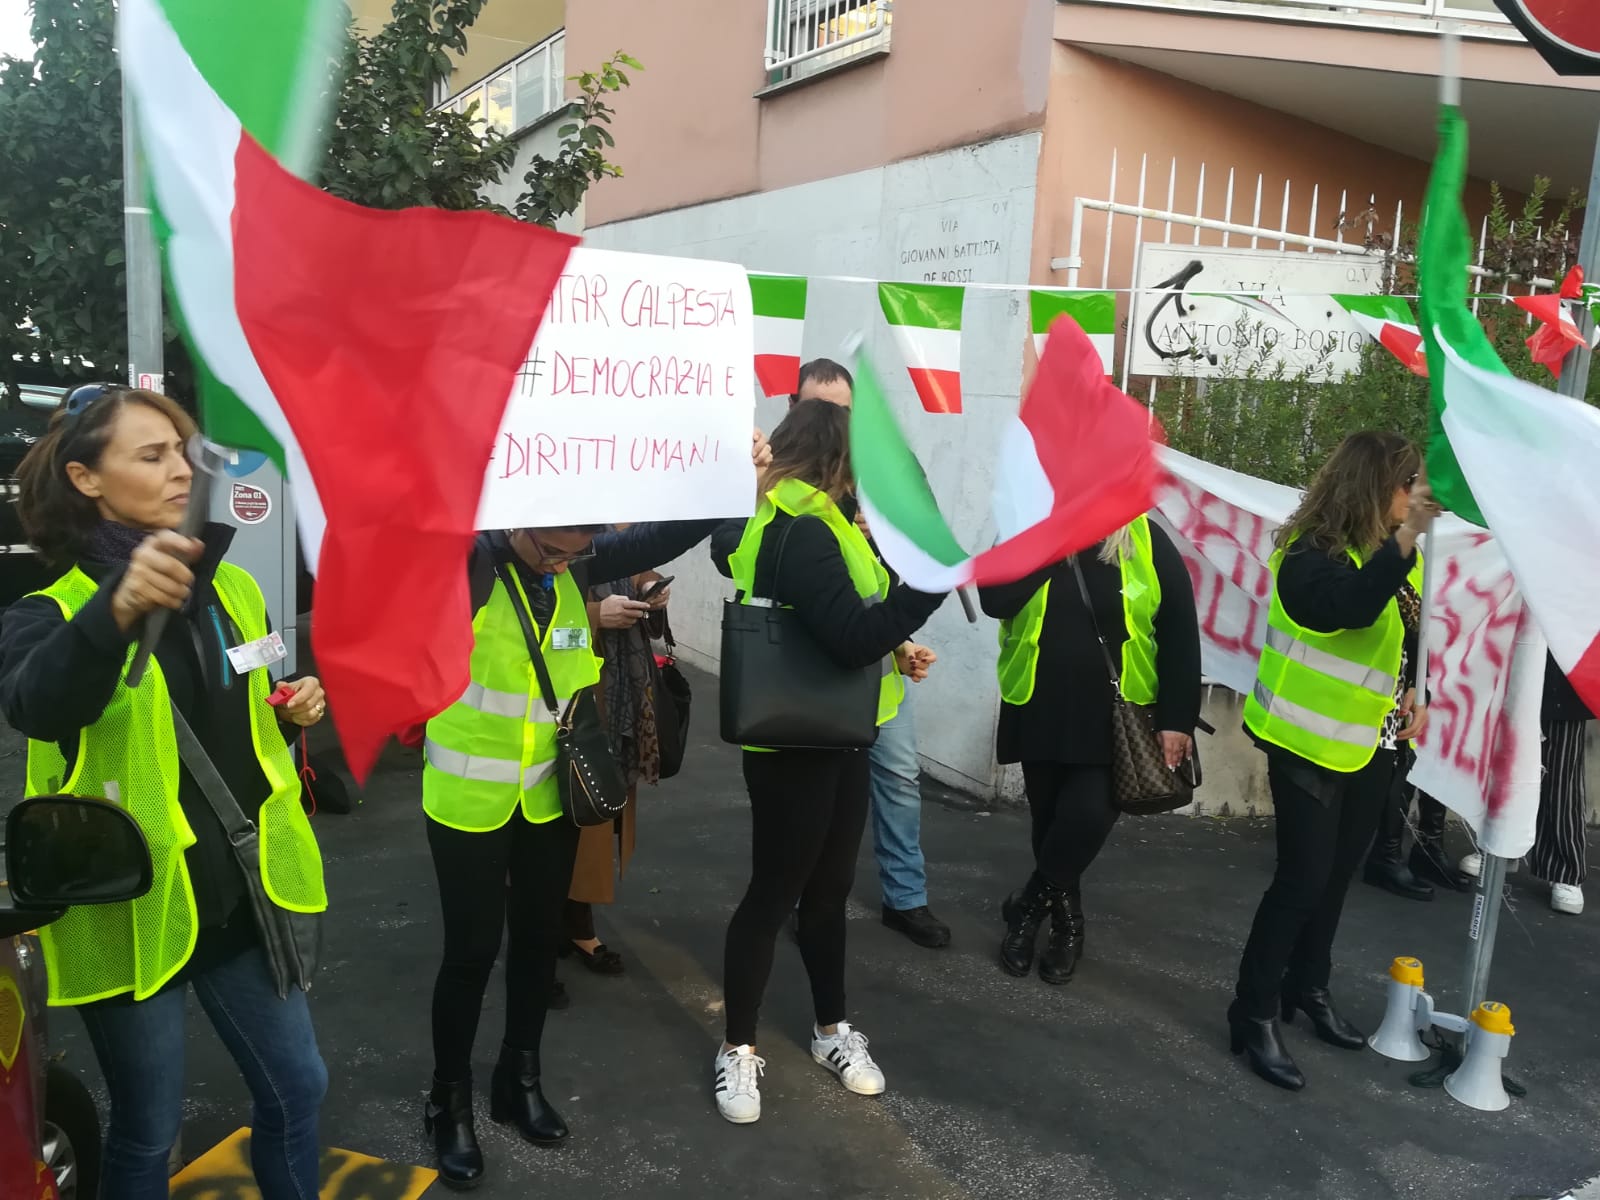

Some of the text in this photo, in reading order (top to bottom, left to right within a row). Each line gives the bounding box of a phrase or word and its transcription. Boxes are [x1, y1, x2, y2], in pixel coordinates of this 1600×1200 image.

[941, 219, 959, 232] VIA
[900, 240, 1000, 264] GIOVANNI BATTISTA
[941, 268, 974, 283] ROSSI
[621, 279, 737, 330] CALPESTA
[1157, 321, 1363, 353] ANTONIO BOSIO
[725, 366, 735, 397] E
[630, 434, 720, 472] UMANI
[234, 491, 262, 499] Zona 01
[1471, 897, 1482, 938] TRASLOCHI
